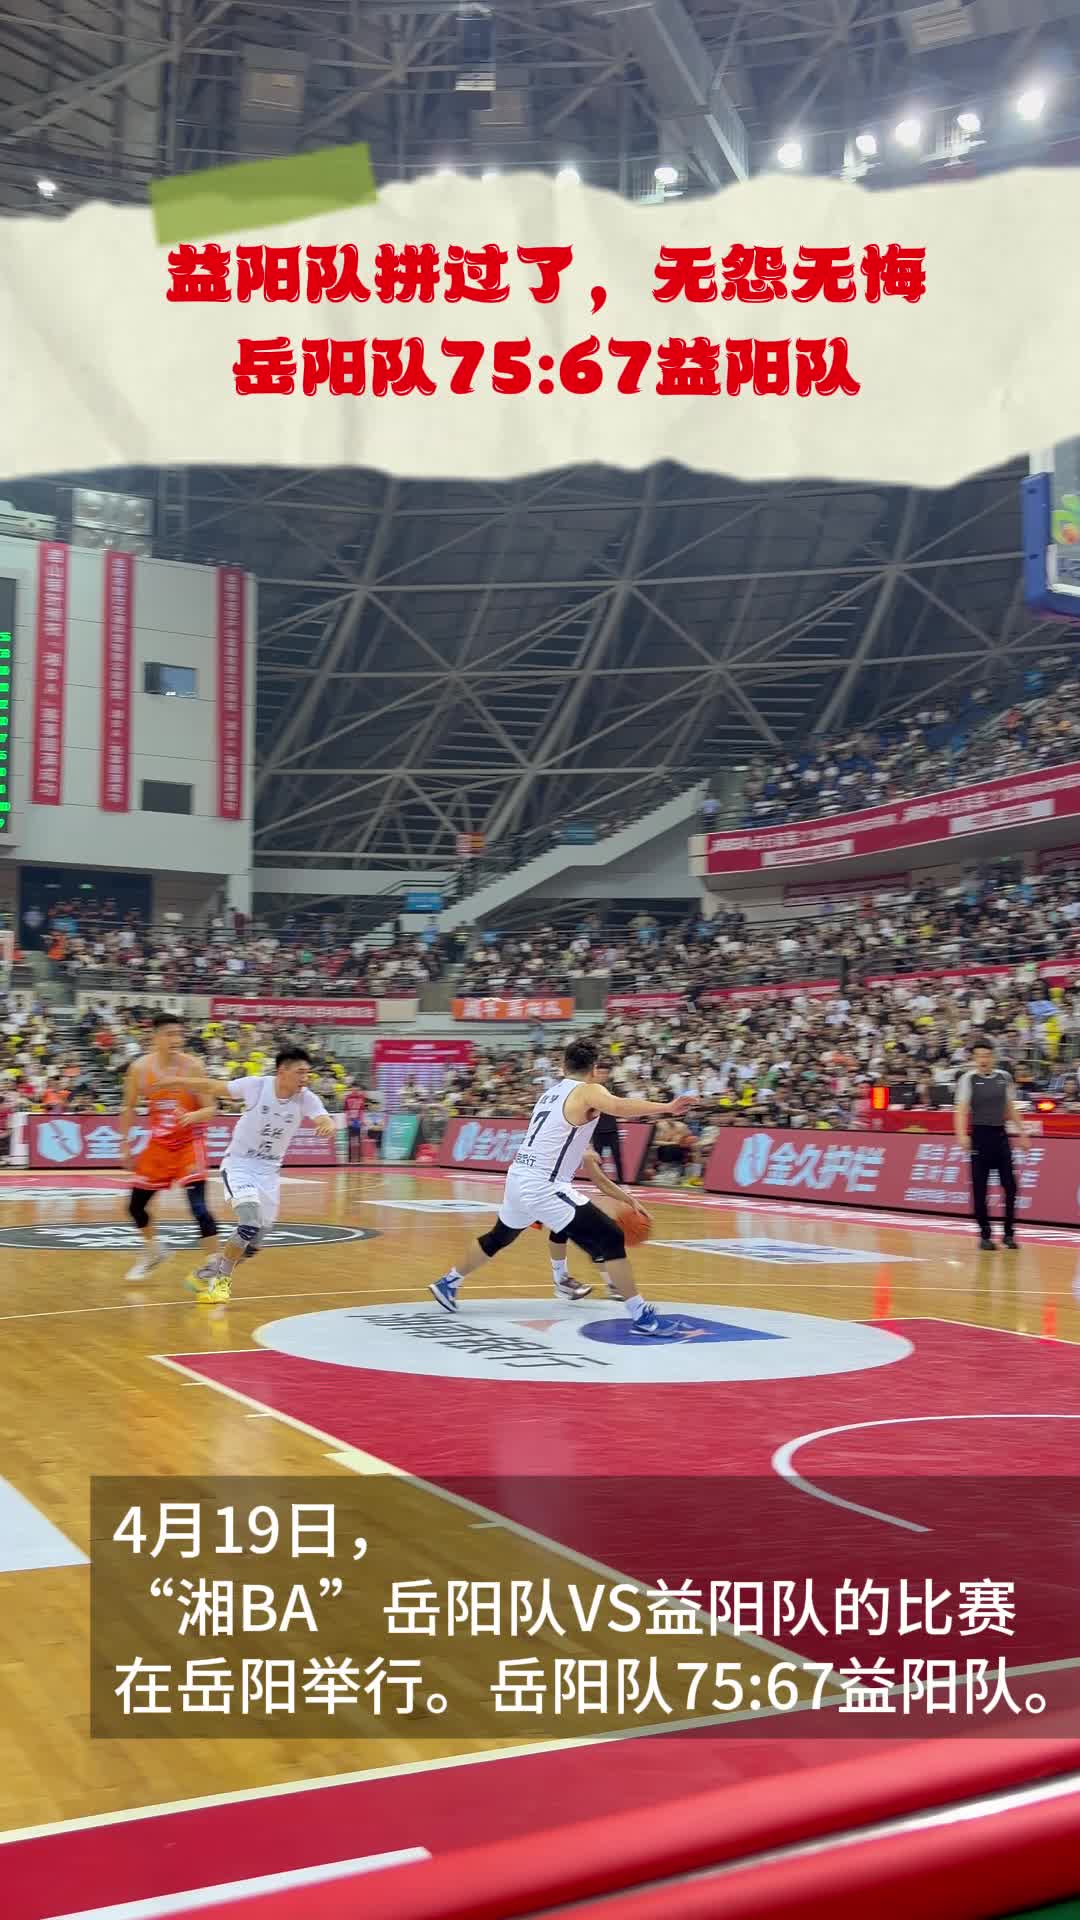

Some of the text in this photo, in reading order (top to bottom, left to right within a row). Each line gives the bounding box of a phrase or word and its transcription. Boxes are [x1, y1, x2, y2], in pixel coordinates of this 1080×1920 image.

[533, 1110, 552, 1147] 7
[767, 1143, 886, 1193] 金久护栏
